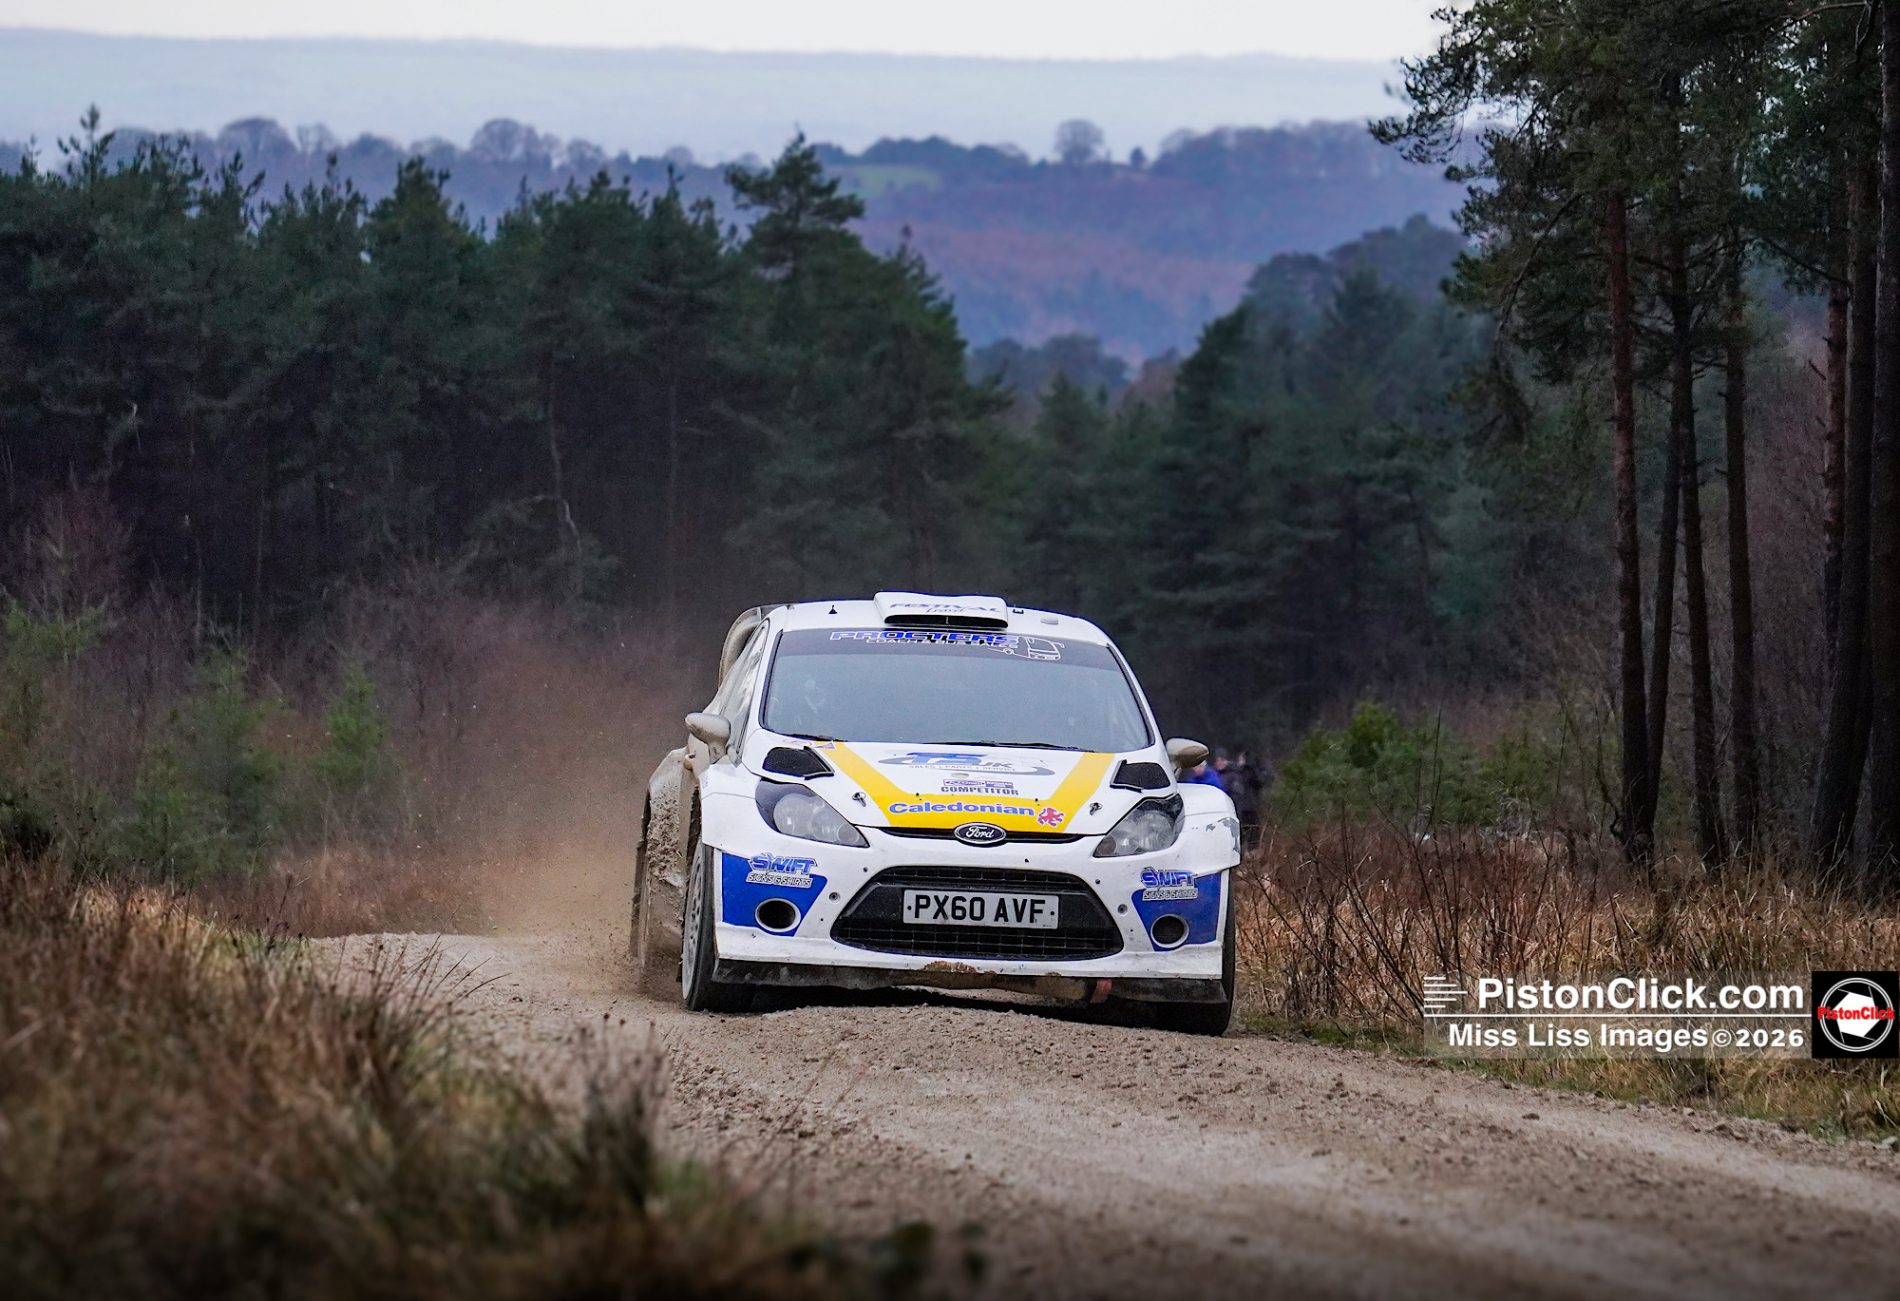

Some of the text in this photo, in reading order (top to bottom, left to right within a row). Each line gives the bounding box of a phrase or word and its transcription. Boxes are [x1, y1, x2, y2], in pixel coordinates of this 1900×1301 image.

[830, 630, 1019, 644] PROCTERS
[940, 786, 1020, 796] COMPETITOR
[888, 801, 1035, 816] Caledonian
[965, 825, 995, 839] Ford
[752, 855, 816, 874] SWIFT
[1141, 868, 1195, 887] SWIFT
[914, 894, 1046, 923] PX60 AVF
